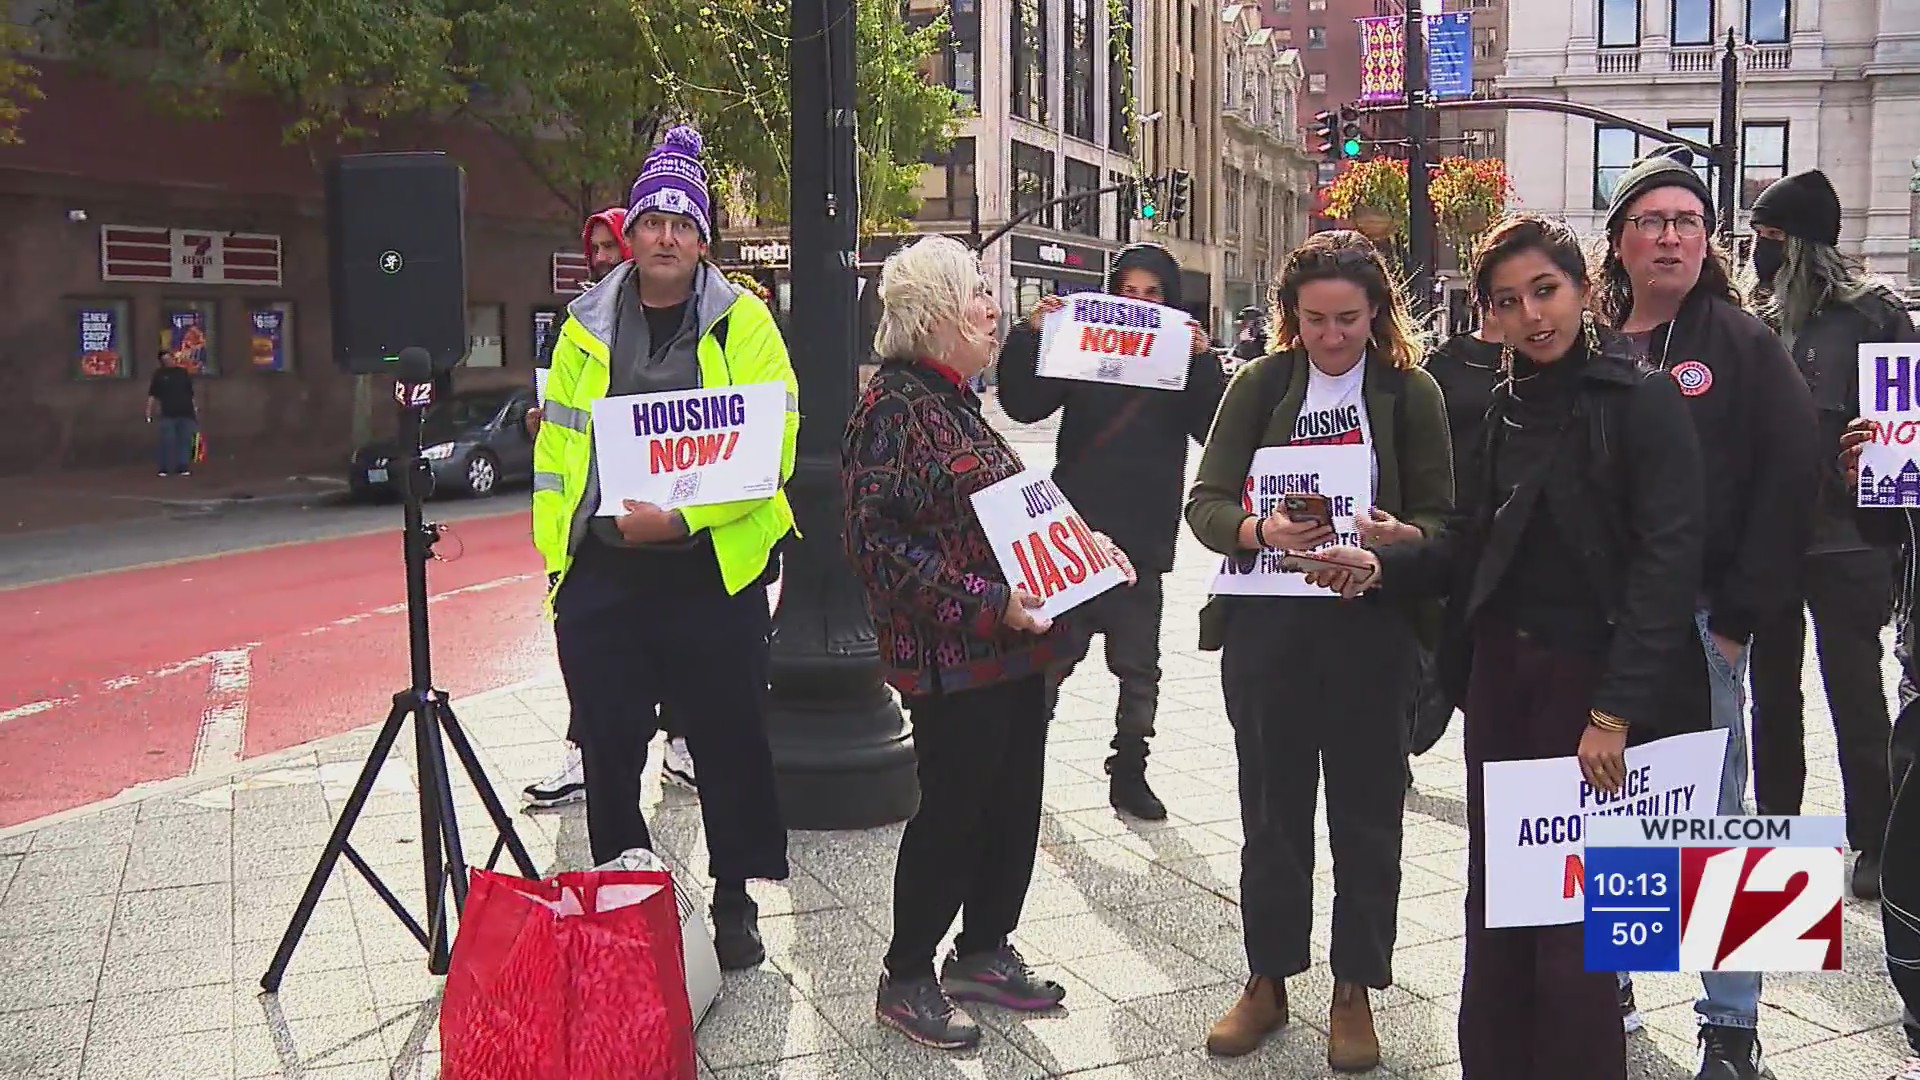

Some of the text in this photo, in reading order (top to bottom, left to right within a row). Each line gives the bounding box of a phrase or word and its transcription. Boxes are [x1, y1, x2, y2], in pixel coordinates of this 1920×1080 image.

[1074, 299, 1162, 329] HOUSING
[1080, 325, 1157, 357] NOW!
[411, 383, 431, 400] 12
[1875, 357, 1920, 412] H
[633, 394, 745, 436] HOUSING
[650, 431, 740, 474] NOW!
